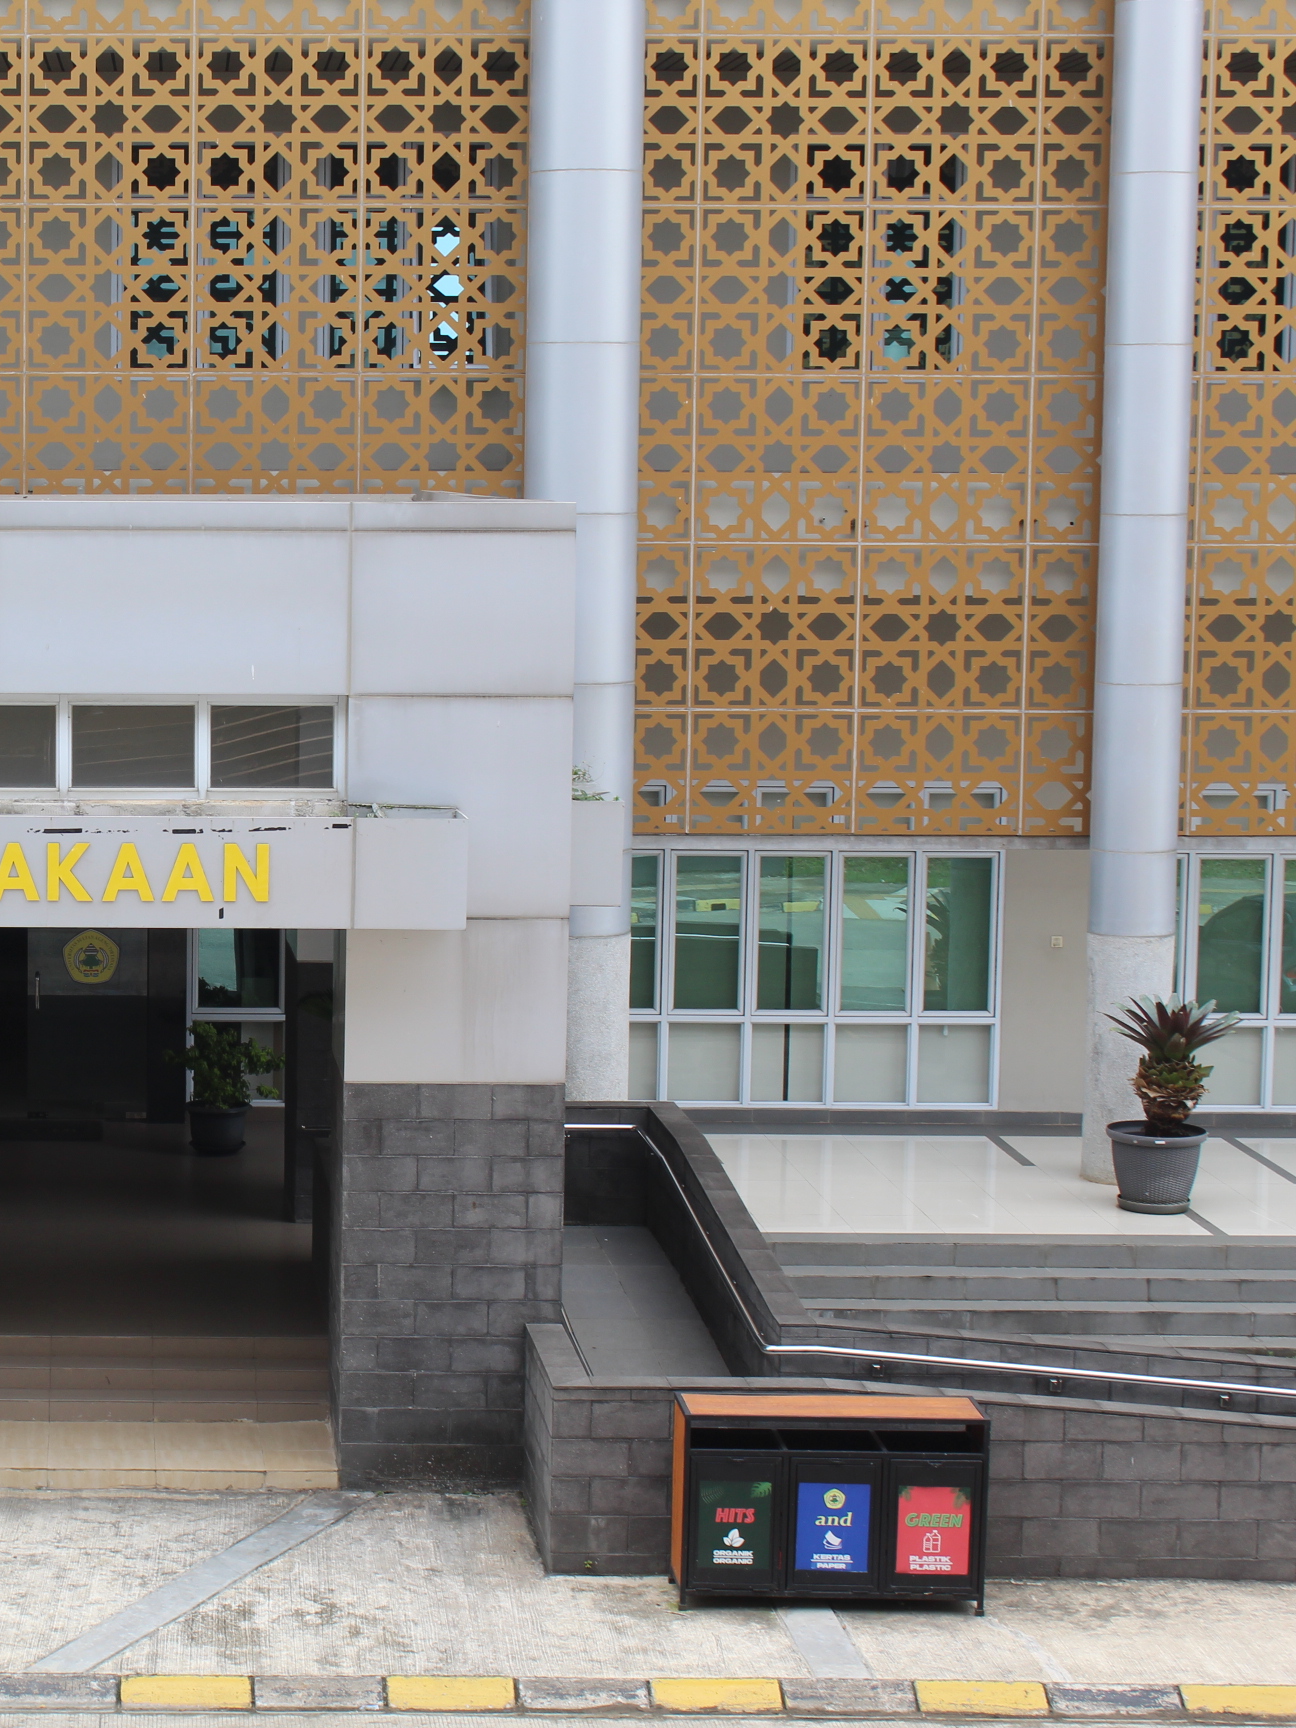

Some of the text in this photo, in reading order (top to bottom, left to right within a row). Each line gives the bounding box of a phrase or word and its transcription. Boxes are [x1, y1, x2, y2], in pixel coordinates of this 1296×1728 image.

[715, 1507, 756, 1524] HITS
[815, 1511, 853, 1527] and
[905, 1512, 963, 1528] GREEN
[712, 1549, 754, 1557] ORGANIK
[813, 1553, 851, 1561] KERTAS
[712, 1557, 754, 1565] ORGANIC
[909, 1555, 951, 1563] PLASTIK
[816, 1562, 847, 1570] PAPER
